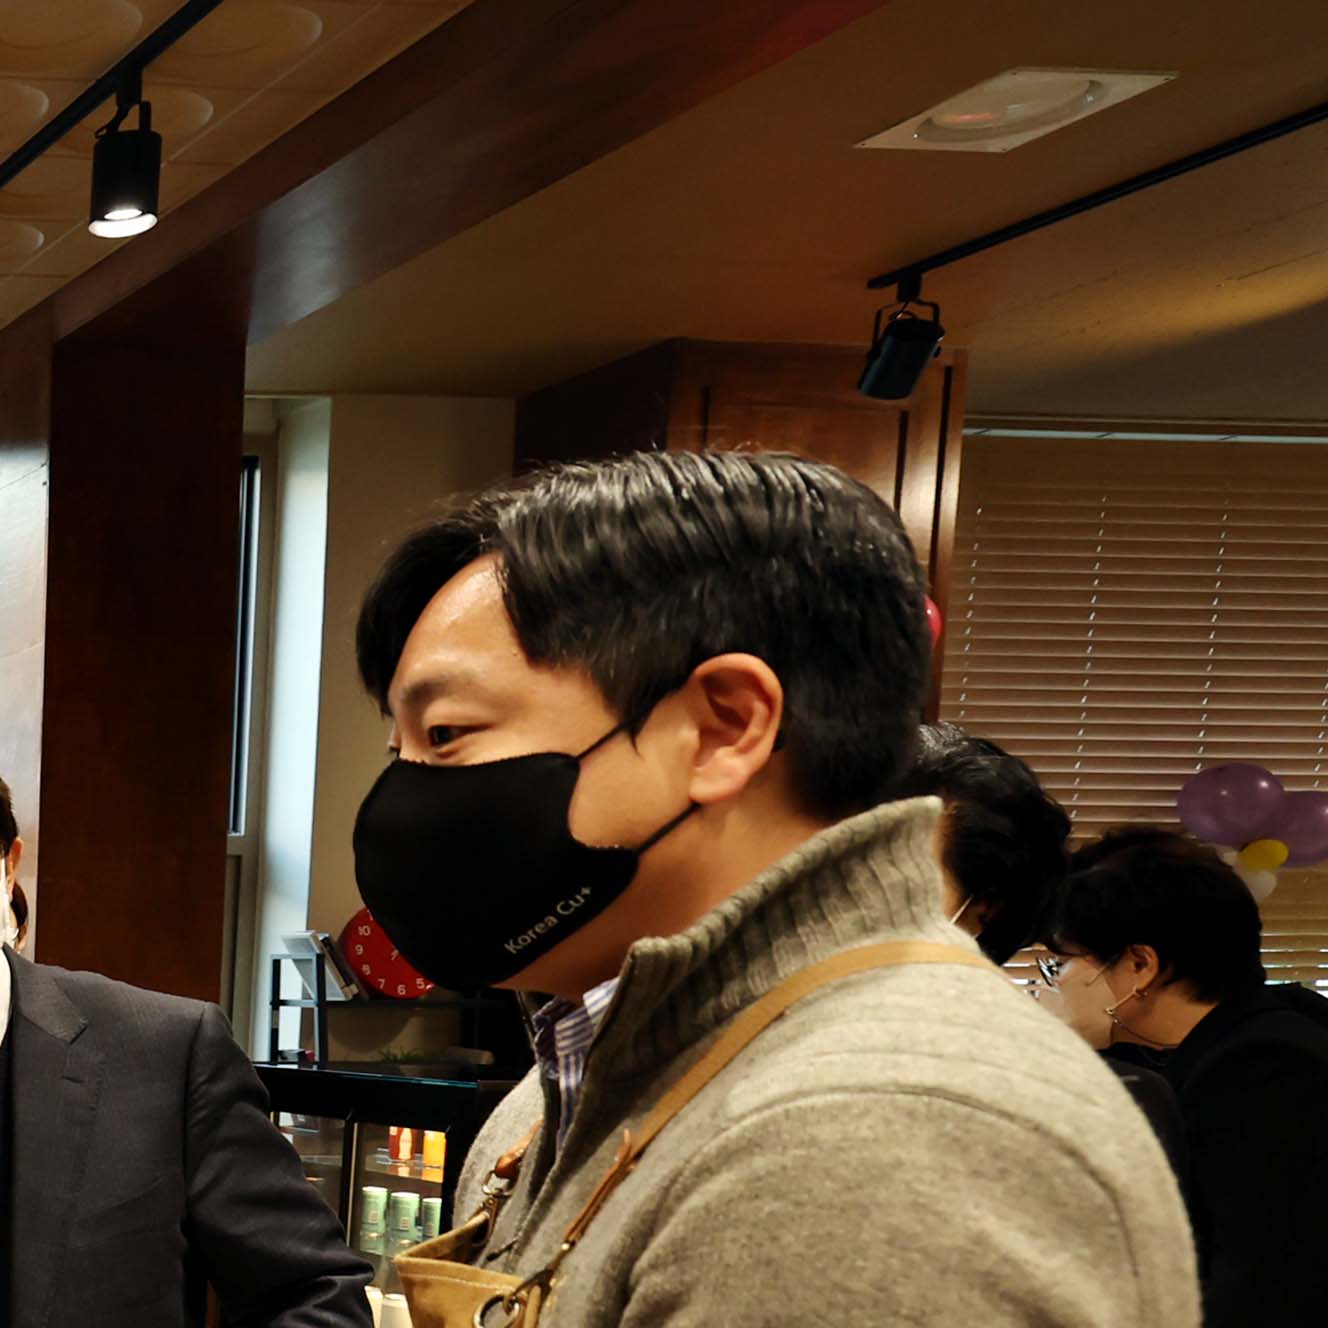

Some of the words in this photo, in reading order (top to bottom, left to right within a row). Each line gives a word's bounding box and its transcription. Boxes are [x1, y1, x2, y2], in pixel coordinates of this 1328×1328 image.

[358, 925, 371, 936] 10
[504, 916, 557, 954] Korea
[355, 944, 364, 955] 9
[362, 964, 371, 976] 8
[377, 978, 385, 989] 7
[416, 978, 424, 989] 5
[397, 984, 406, 995] 6
